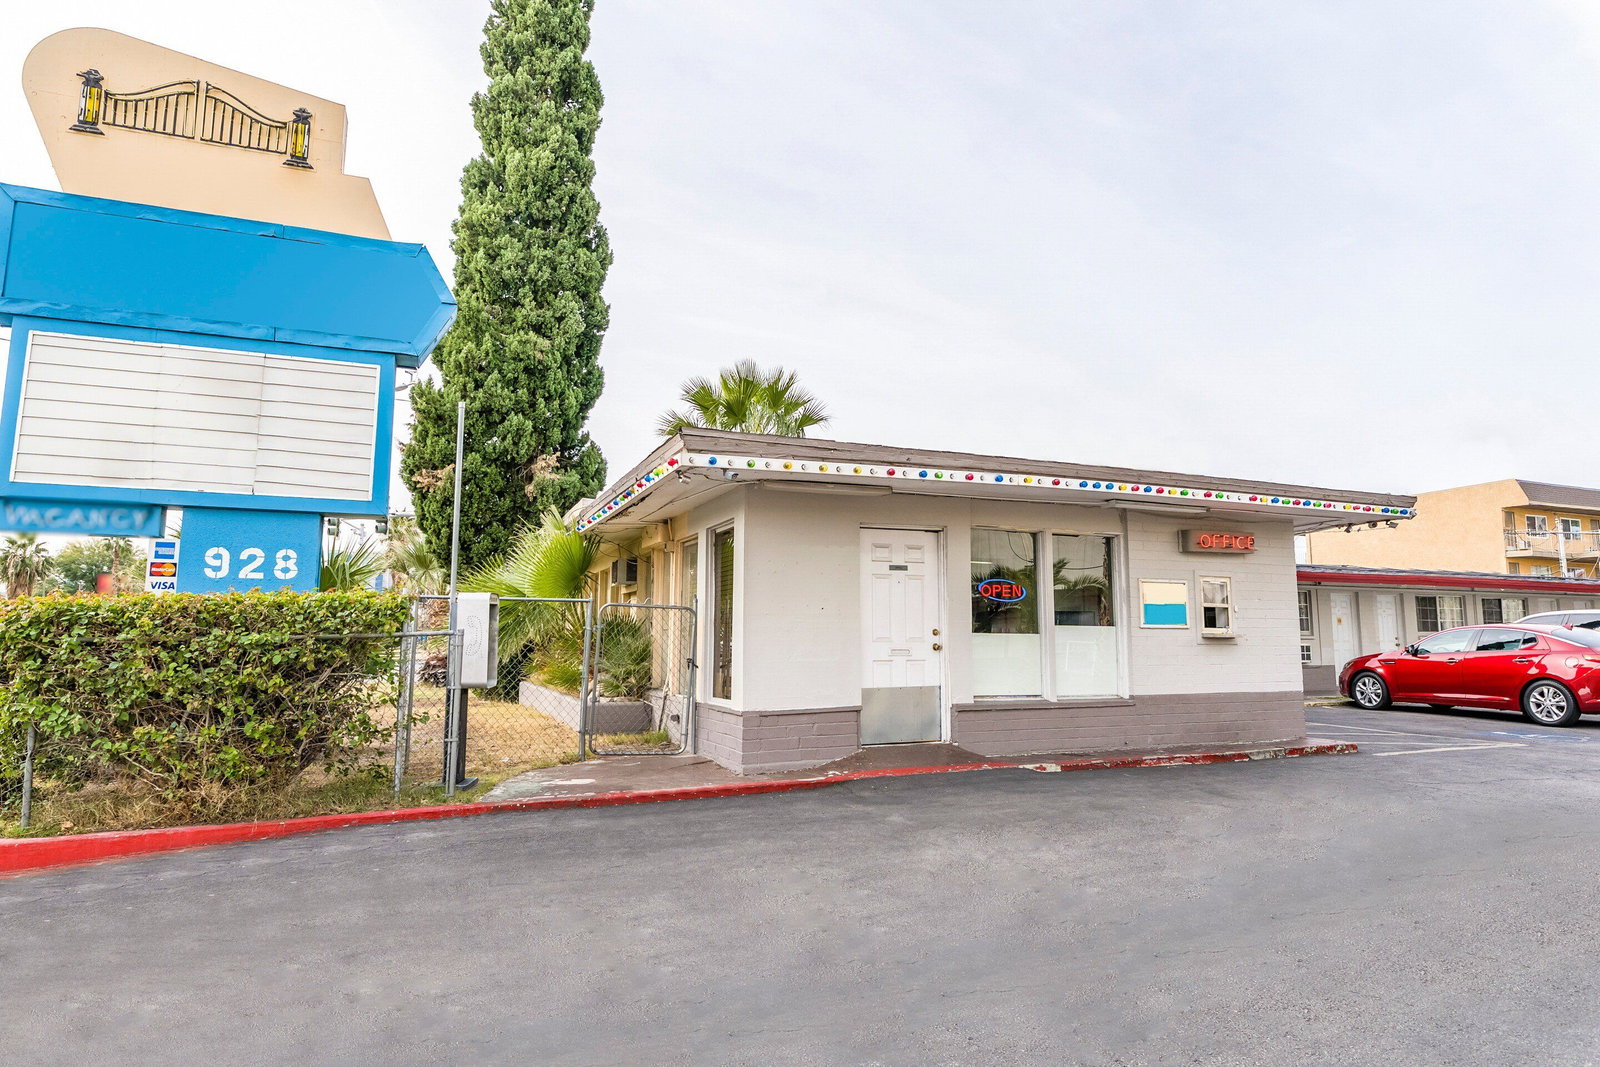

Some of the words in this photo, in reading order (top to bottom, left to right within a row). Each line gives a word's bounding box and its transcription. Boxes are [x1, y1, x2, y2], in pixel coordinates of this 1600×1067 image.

[1200, 534, 1255, 550] OFFICE
[203, 547, 298, 580] 928
[151, 581, 175, 590] VISA
[981, 584, 1022, 597] OPEN
